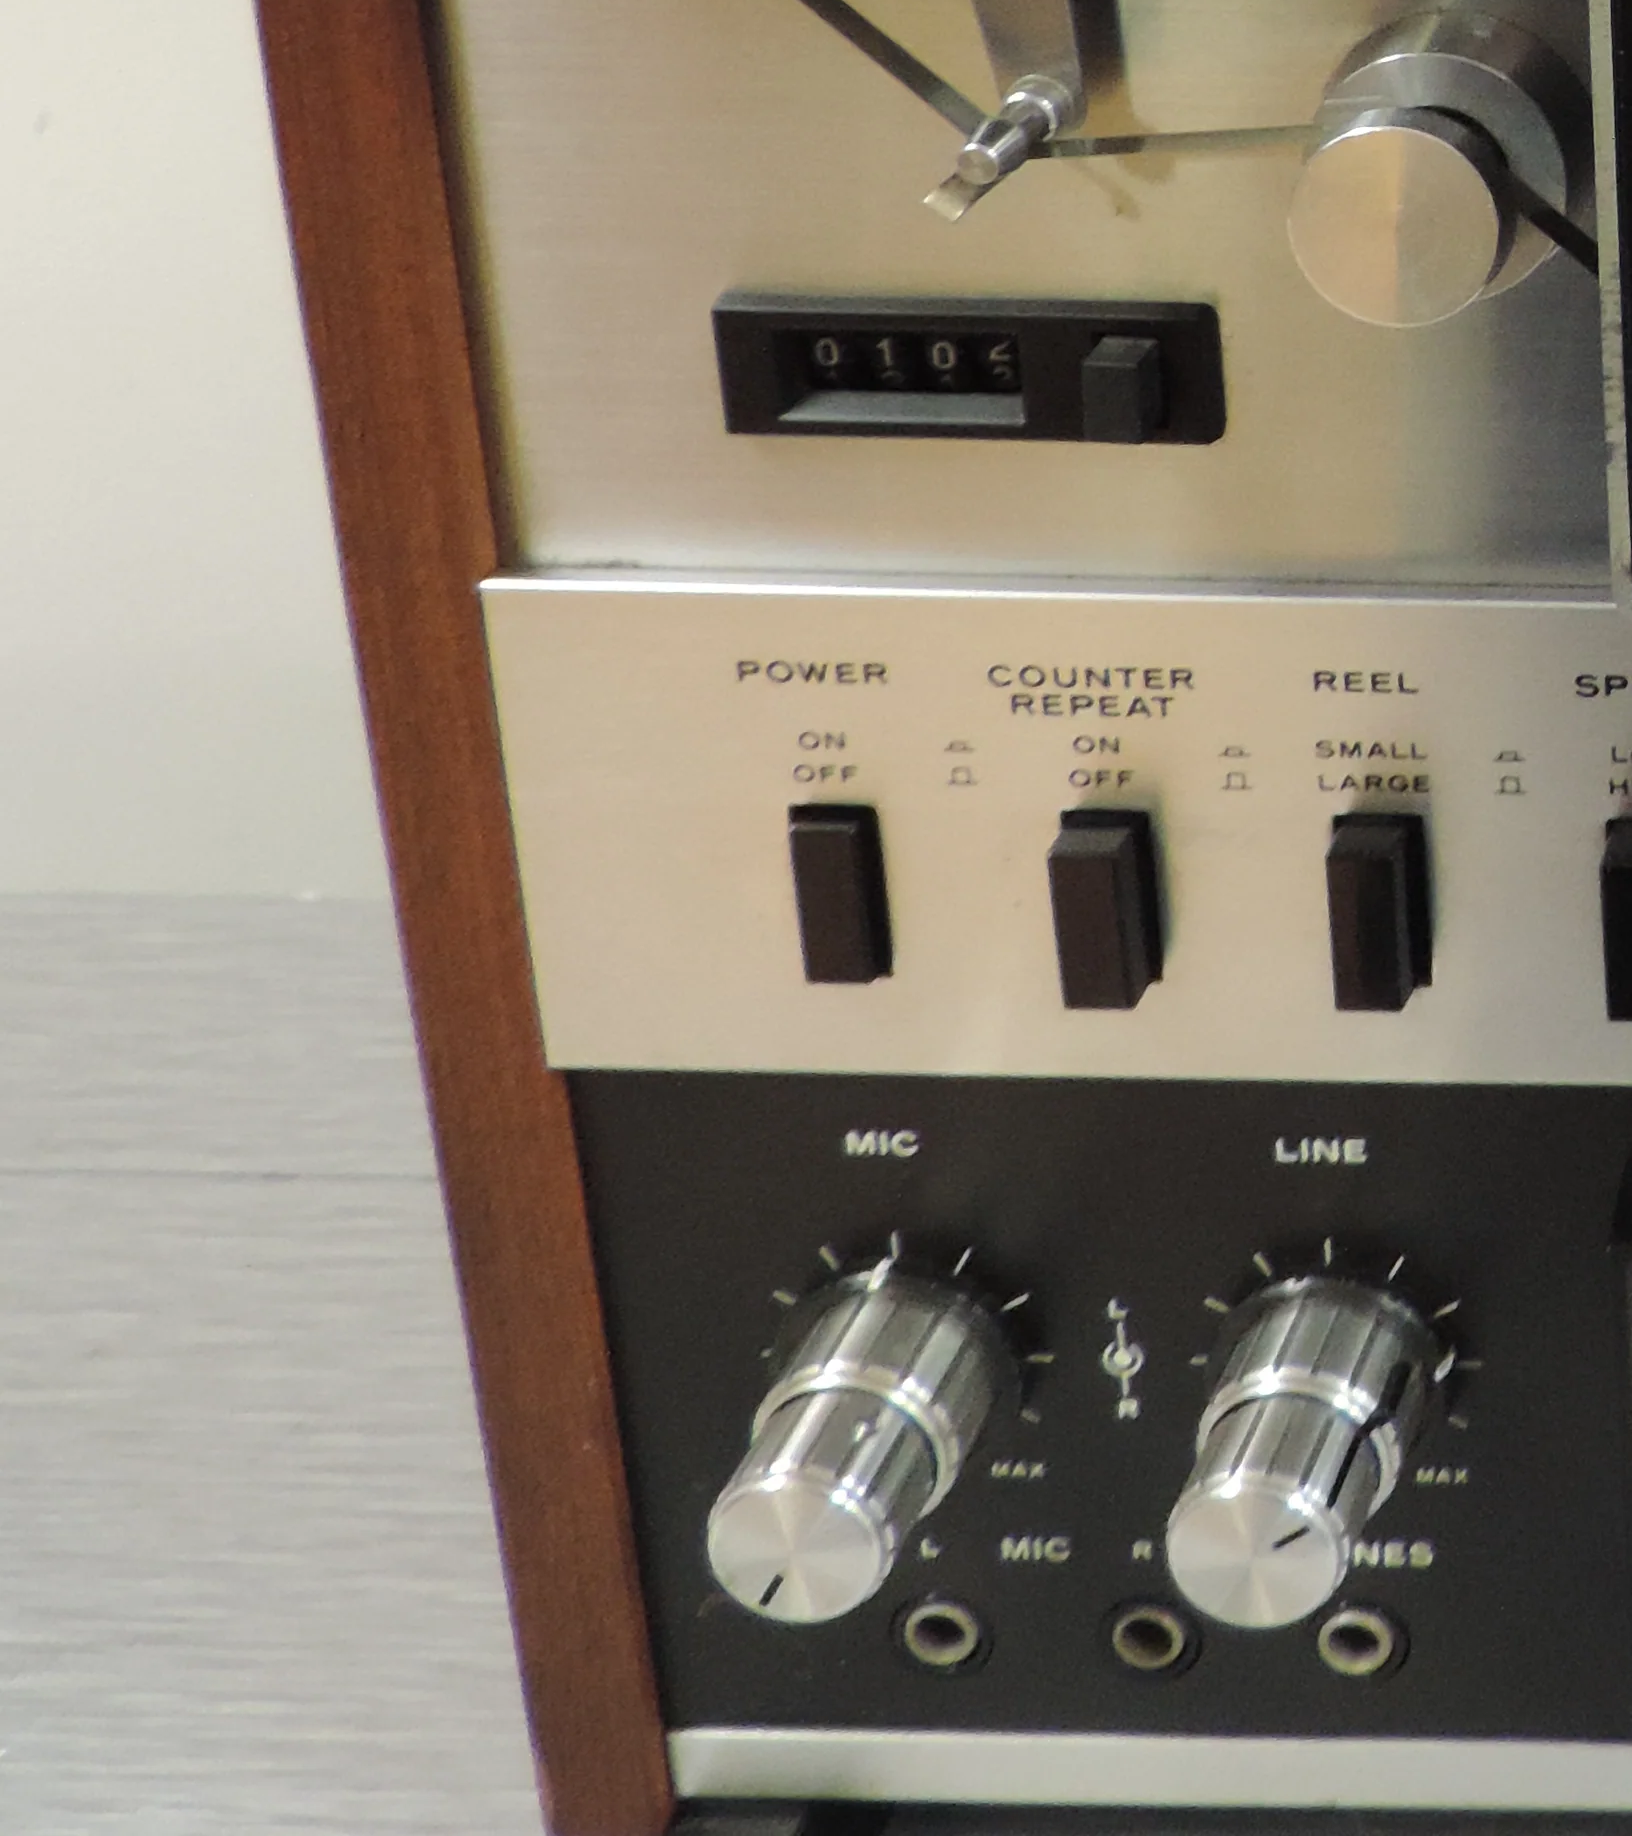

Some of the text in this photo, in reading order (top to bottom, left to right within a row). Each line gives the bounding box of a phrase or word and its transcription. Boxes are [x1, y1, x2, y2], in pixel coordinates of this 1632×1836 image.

[736, 660, 889, 685] POWER
[987, 664, 1195, 690] COUNTER
[1313, 670, 1420, 694] REEL
[1010, 694, 1175, 718] REPEAT
[798, 730, 846, 751] ON
[1073, 734, 1121, 756] ON
[1315, 740, 1428, 761] SMALL
[793, 764, 857, 784] OFF
[1068, 768, 1134, 789] OFF
[1318, 773, 1431, 794] LARGE
[844, 1129, 920, 1158] MIC
[1274, 1136, 1369, 1164] LINE
[991, 1462, 1046, 1479] MAX
[1416, 1466, 1469, 1484] MAX
[1001, 1536, 1071, 1562] MIC
